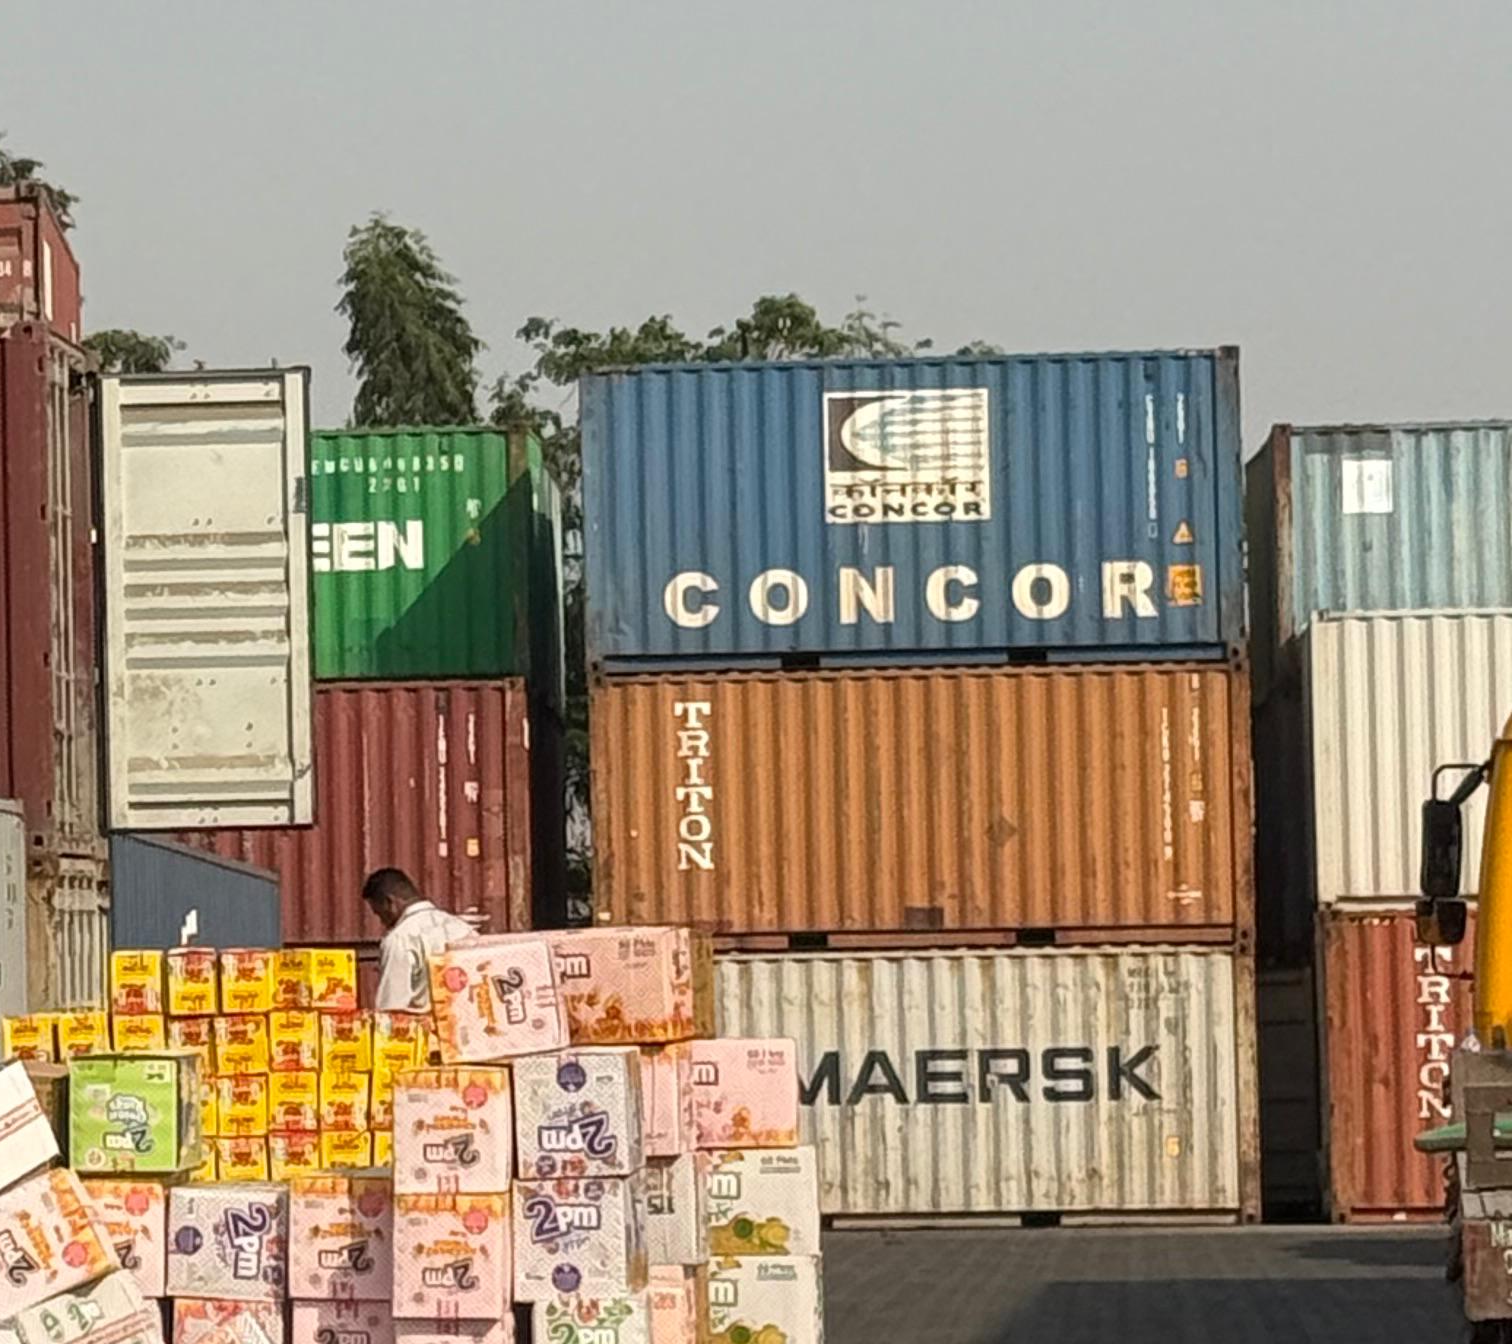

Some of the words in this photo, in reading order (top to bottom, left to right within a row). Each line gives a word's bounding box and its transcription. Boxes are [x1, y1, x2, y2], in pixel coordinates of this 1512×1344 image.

[828, 502, 983, 519] CONCOR
[663, 560, 1159, 630] CONCOR
[673, 700, 716, 871] TRITON
[491, 965, 529, 1026] 2pm
[1414, 946, 1456, 1120] TRITON
[536, 1108, 620, 1161] 2pm
[224, 1200, 273, 1281] 2pm
[522, 1194, 603, 1243] 2pm
